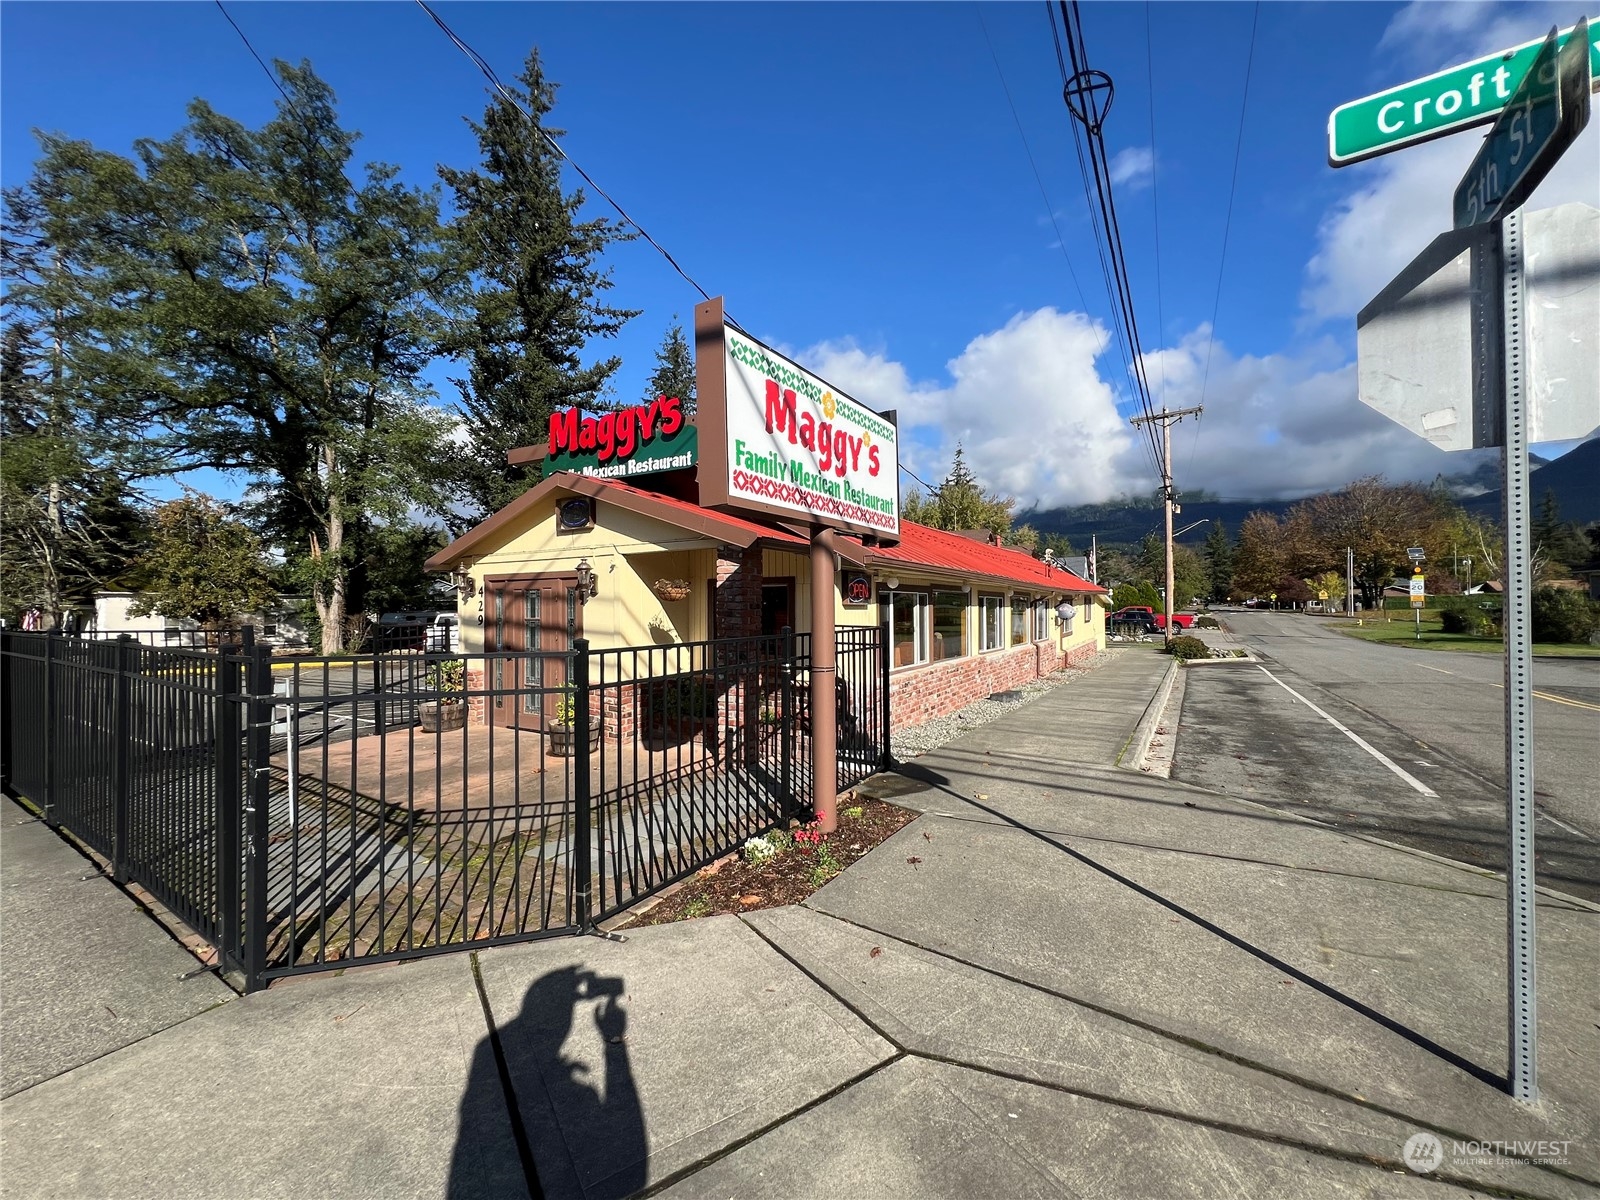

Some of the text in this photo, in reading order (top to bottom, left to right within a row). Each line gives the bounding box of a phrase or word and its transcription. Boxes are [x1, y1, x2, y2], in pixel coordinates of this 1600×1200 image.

[1377, 64, 1511, 134] Croft
[1467, 95, 1535, 227] 5th St
[549, 394, 682, 461] Maggy's
[765, 379, 880, 477] Maggy's
[582, 463, 626, 478] Mexican
[627, 451, 693, 475] Restaurant
[735, 439, 894, 515] Family Mexican Restaurant
[849, 583, 869, 598] OPEN
